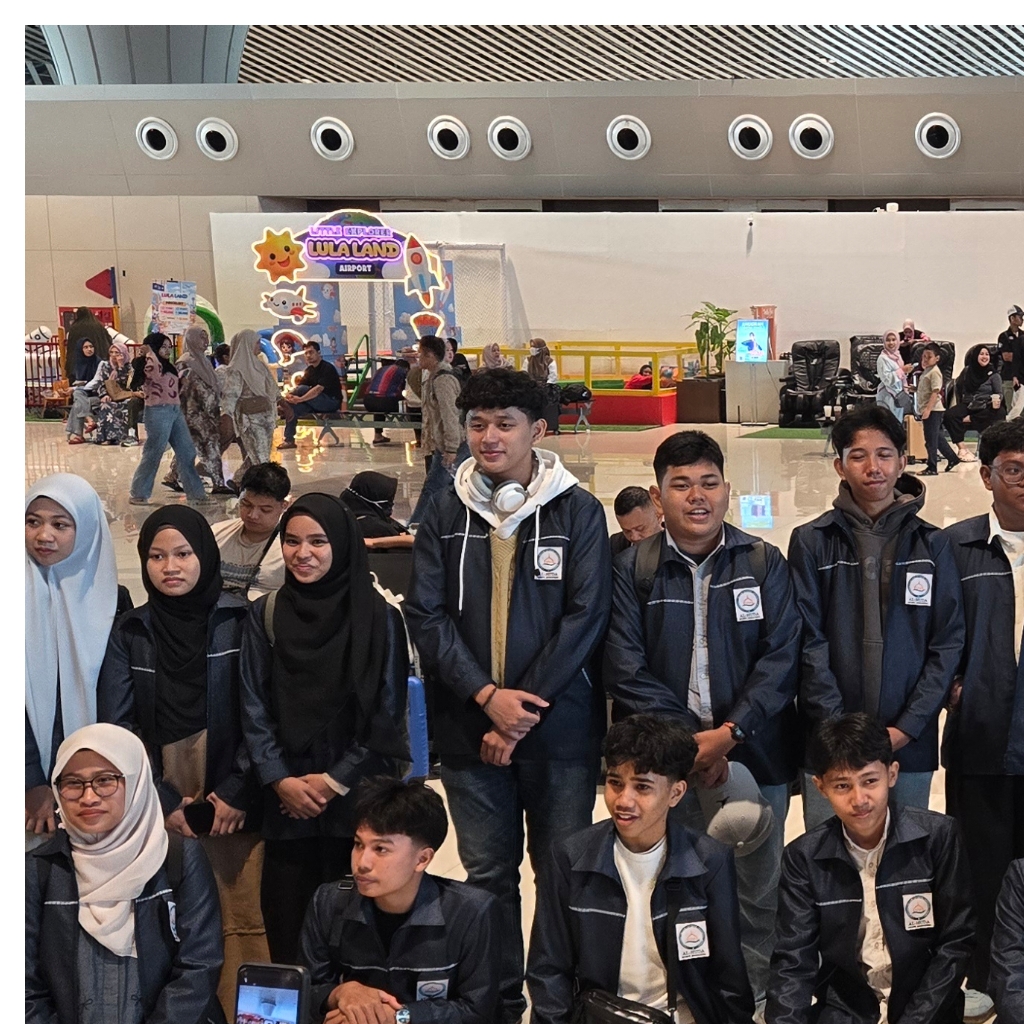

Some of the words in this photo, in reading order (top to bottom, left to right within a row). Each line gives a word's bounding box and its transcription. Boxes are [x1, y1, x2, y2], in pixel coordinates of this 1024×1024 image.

[308, 241, 350, 257] LULA
[352, 241, 400, 258] LAND
[339, 264, 373, 272] AIRPORT
